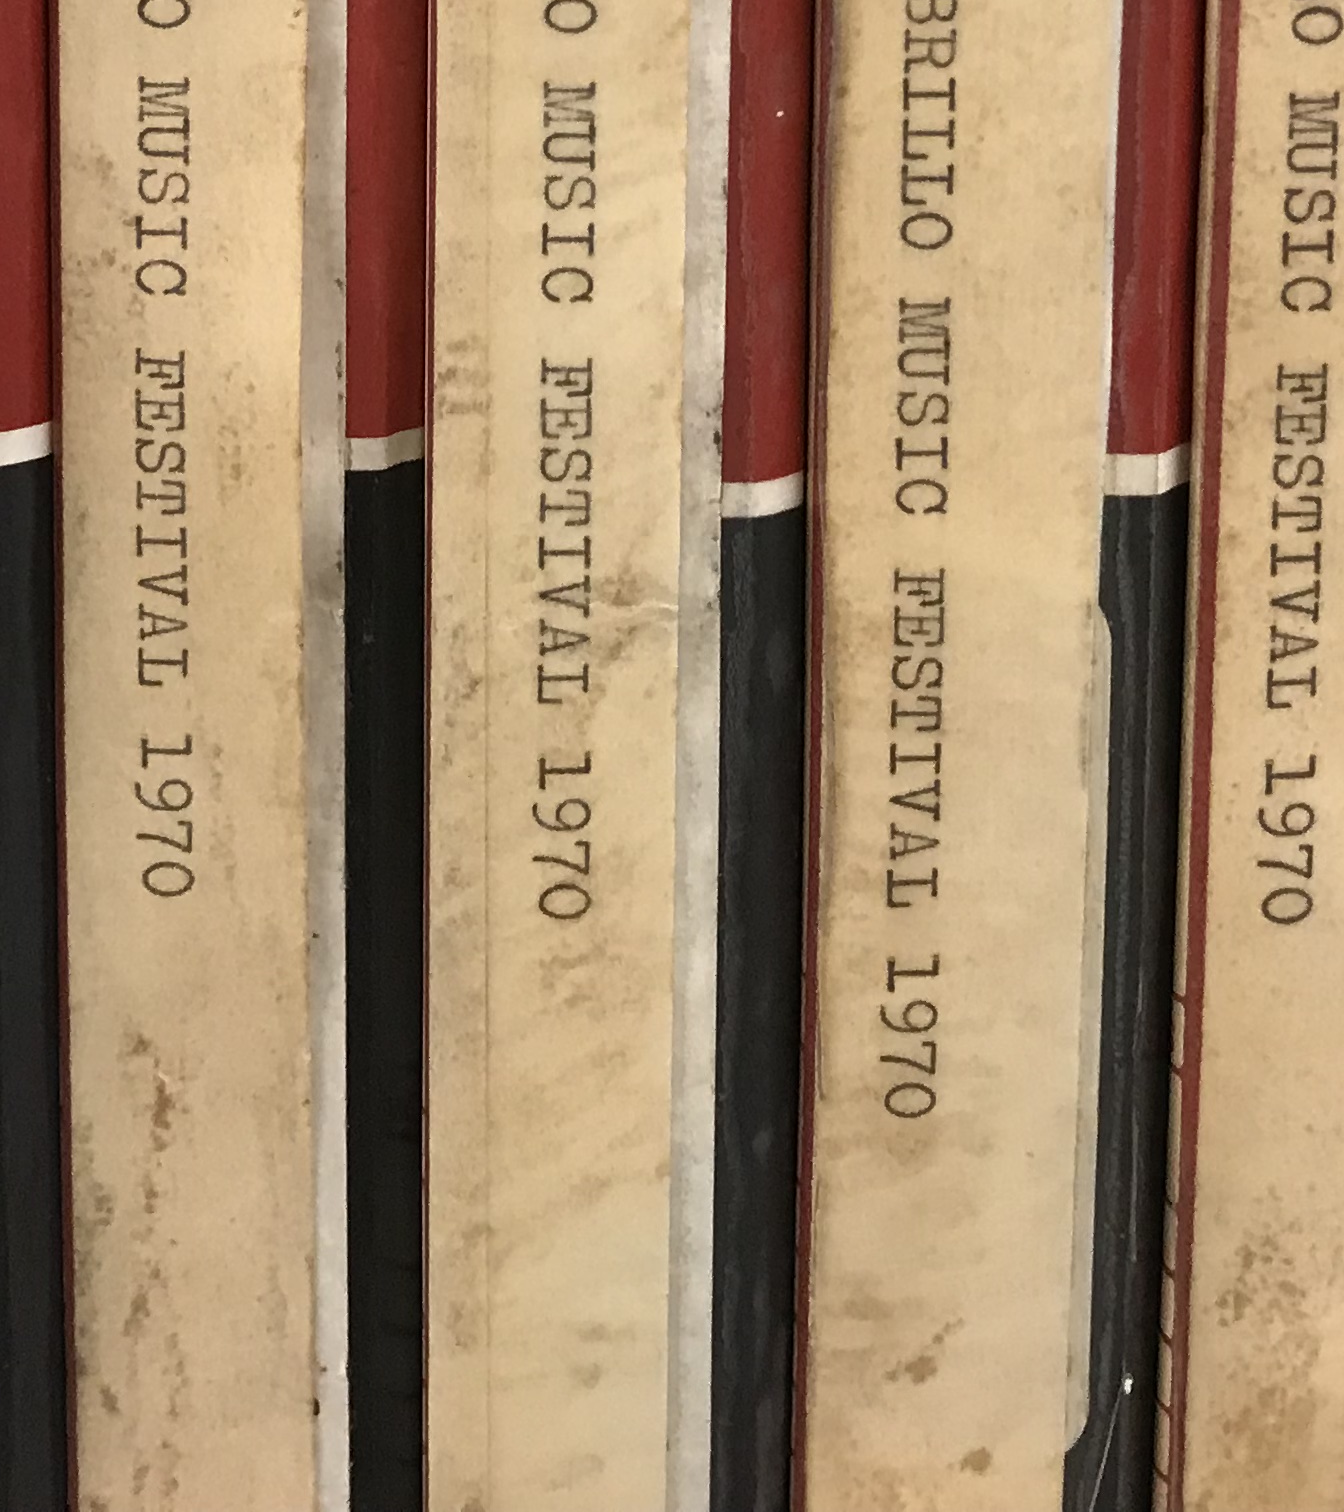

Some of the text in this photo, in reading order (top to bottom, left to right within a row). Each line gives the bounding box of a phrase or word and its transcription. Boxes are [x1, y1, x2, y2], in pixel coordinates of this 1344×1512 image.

[135, 75, 192, 299] MUSIC
[540, 81, 598, 306] MUSIC
[1279, 91, 1341, 317] MUSIC
[134, 346, 192, 690] FESTIVAL
[893, 295, 952, 517] MUSIC
[536, 356, 595, 706] FESTIVAL
[1265, 363, 1329, 712] FESTIVAL
[134, 732, 196, 900] 1970
[532, 756, 593, 922] 1970
[884, 567, 947, 912] FESTIVAL
[1256, 754, 1317, 927] 1970
[878, 954, 942, 1121] 1970
